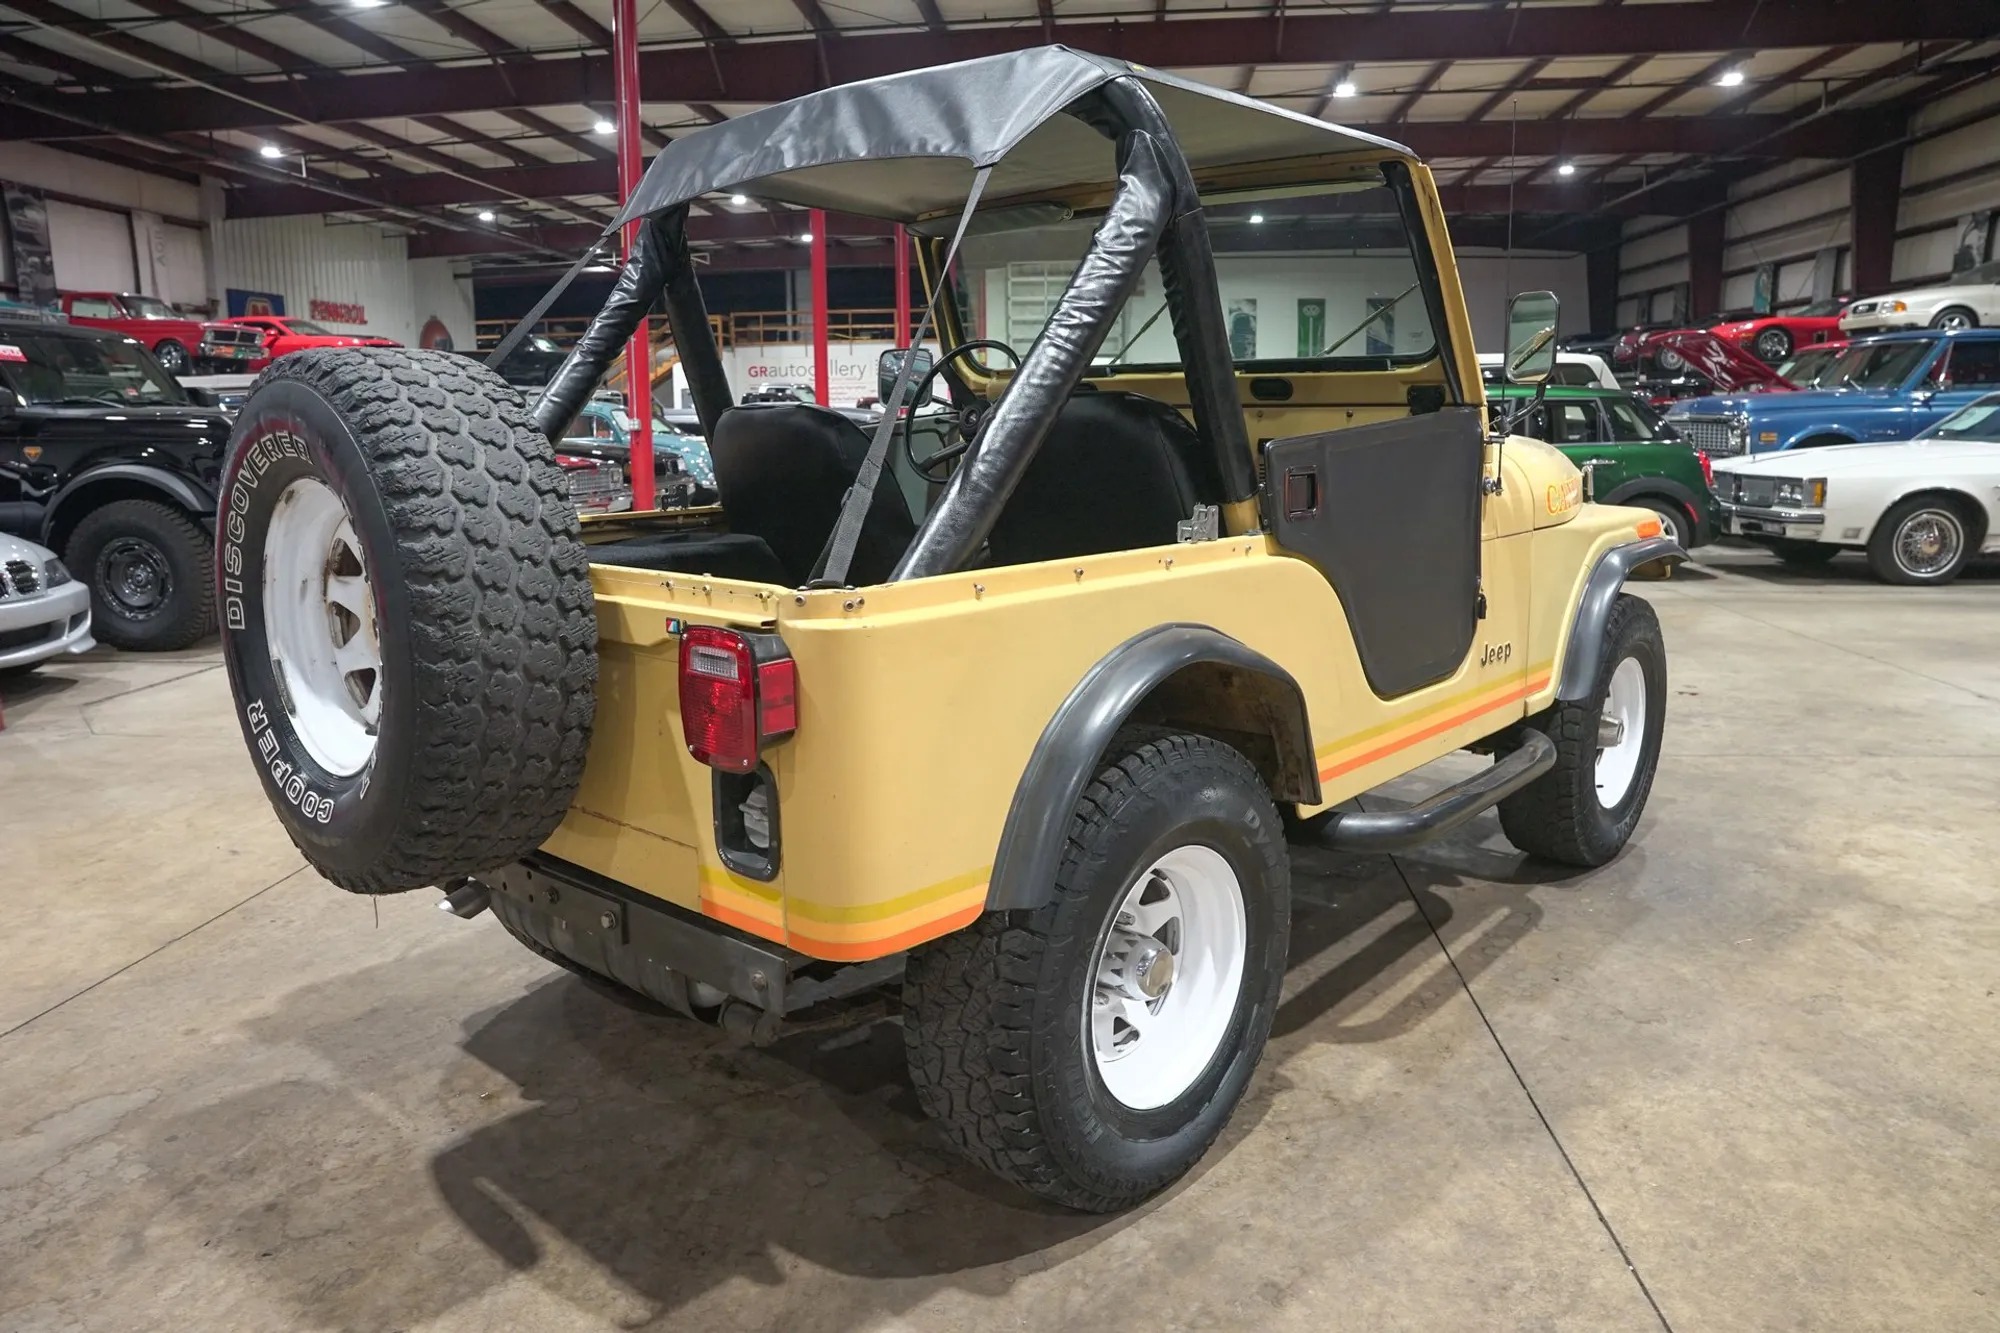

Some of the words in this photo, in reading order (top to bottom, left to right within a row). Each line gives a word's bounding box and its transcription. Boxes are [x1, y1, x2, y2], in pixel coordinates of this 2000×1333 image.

[748, 359, 867, 381] GRautogllery
[225, 430, 315, 631] DISCOVERER
[1480, 641, 1512, 667] Jeep
[247, 698, 336, 824] COOPER
